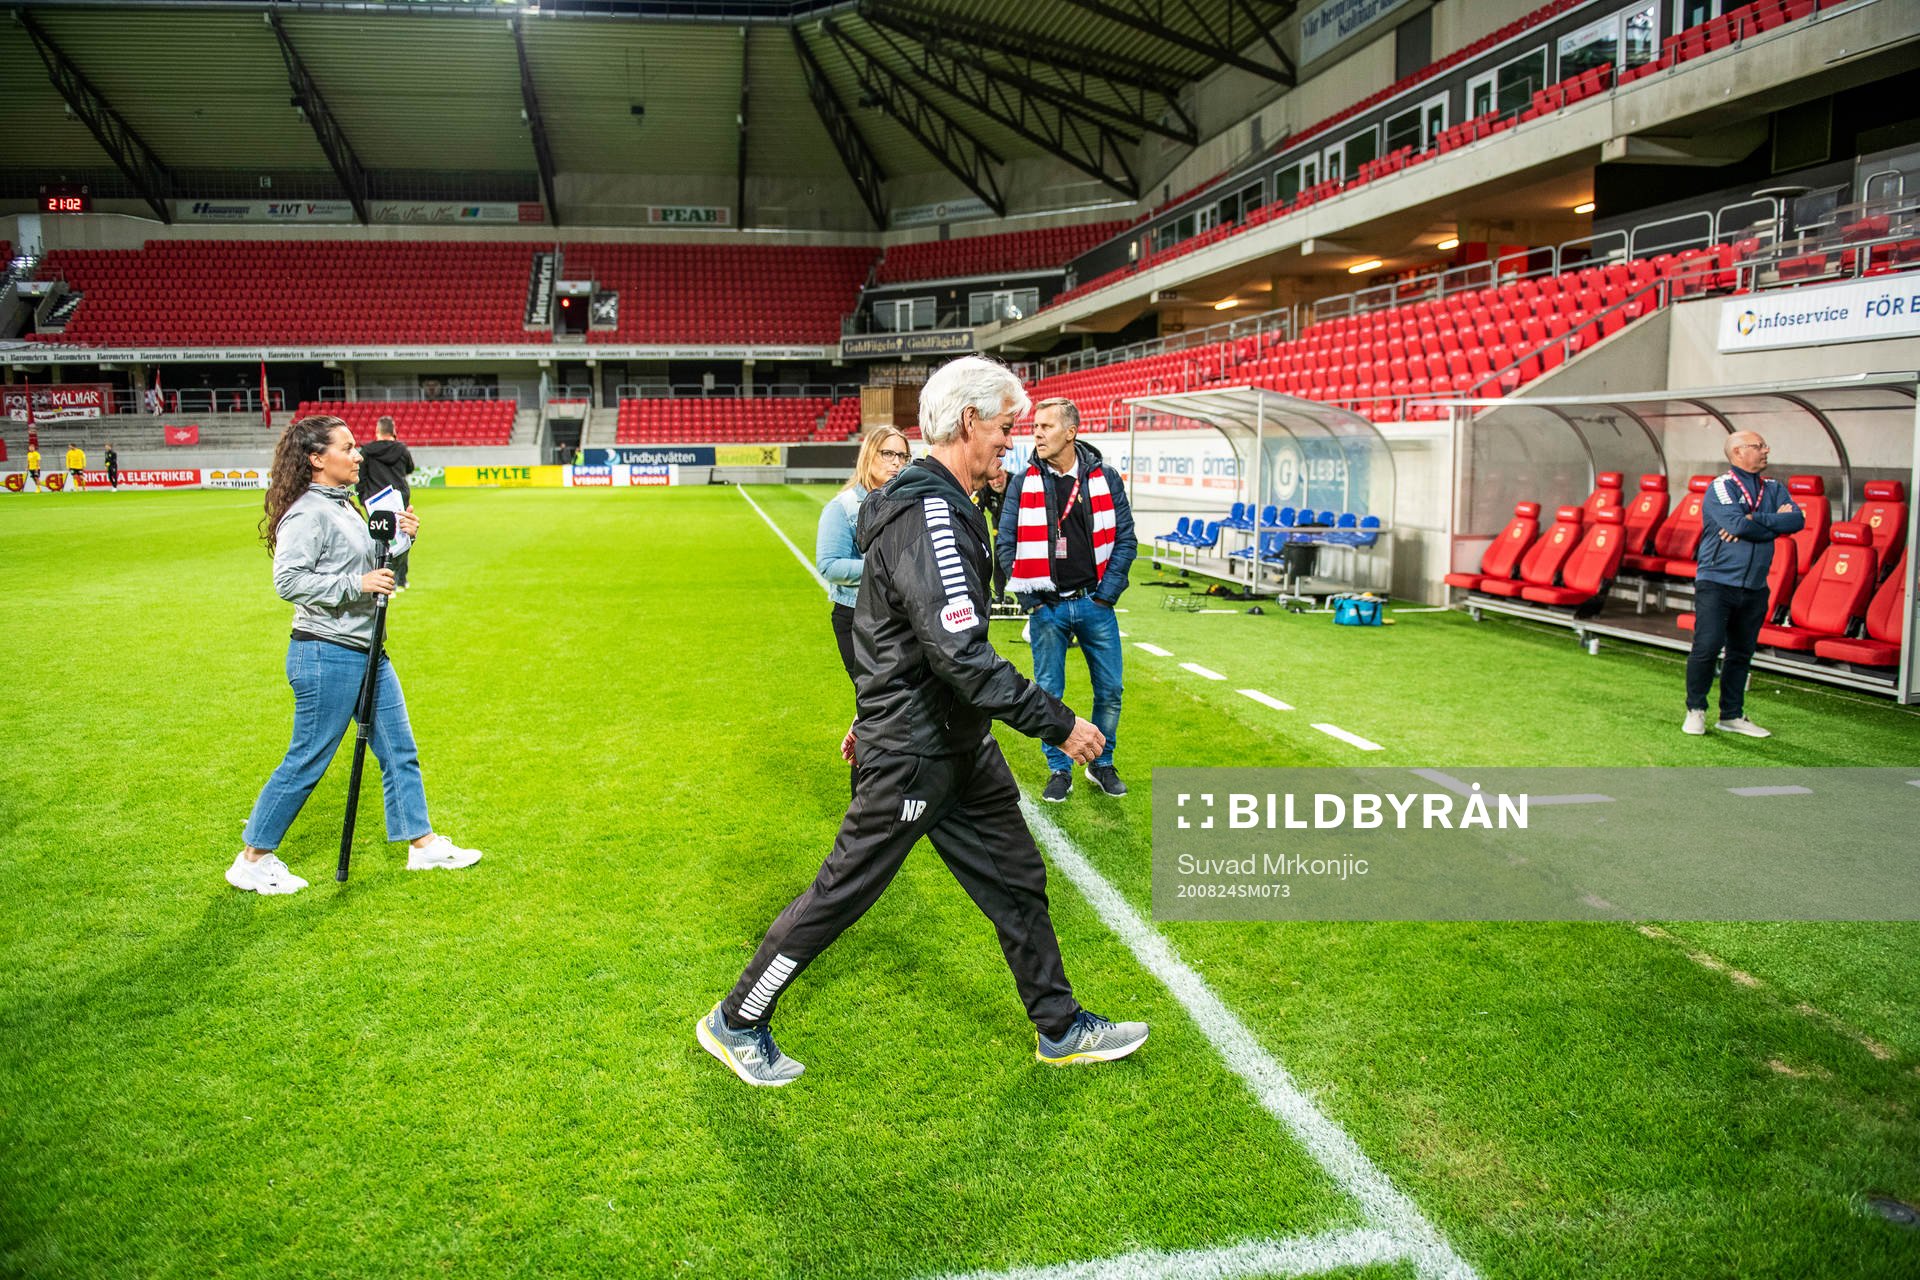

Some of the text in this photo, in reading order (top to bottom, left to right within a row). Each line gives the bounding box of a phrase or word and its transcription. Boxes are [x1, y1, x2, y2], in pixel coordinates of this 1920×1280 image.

[48, 198, 81, 210] 21:02
[281, 203, 301, 215] IVT
[661, 208, 717, 222] PEAB
[1865, 294, 1904, 318] FÖR
[1758, 306, 1849, 329] infoservice
[52, 390, 99, 405] KALMAR
[622, 451, 696, 466] Lindbytvätten
[477, 467, 531, 480] HYLTE
[574, 466, 612, 475] SPORT
[631, 466, 669, 475] SPORT
[83, 471, 126, 483] RIKTIA
[127, 471, 194, 482] ELEKTRIKER
[573, 476, 612, 486] VISION
[631, 476, 668, 486] VISION
[370, 519, 389, 531] svt
